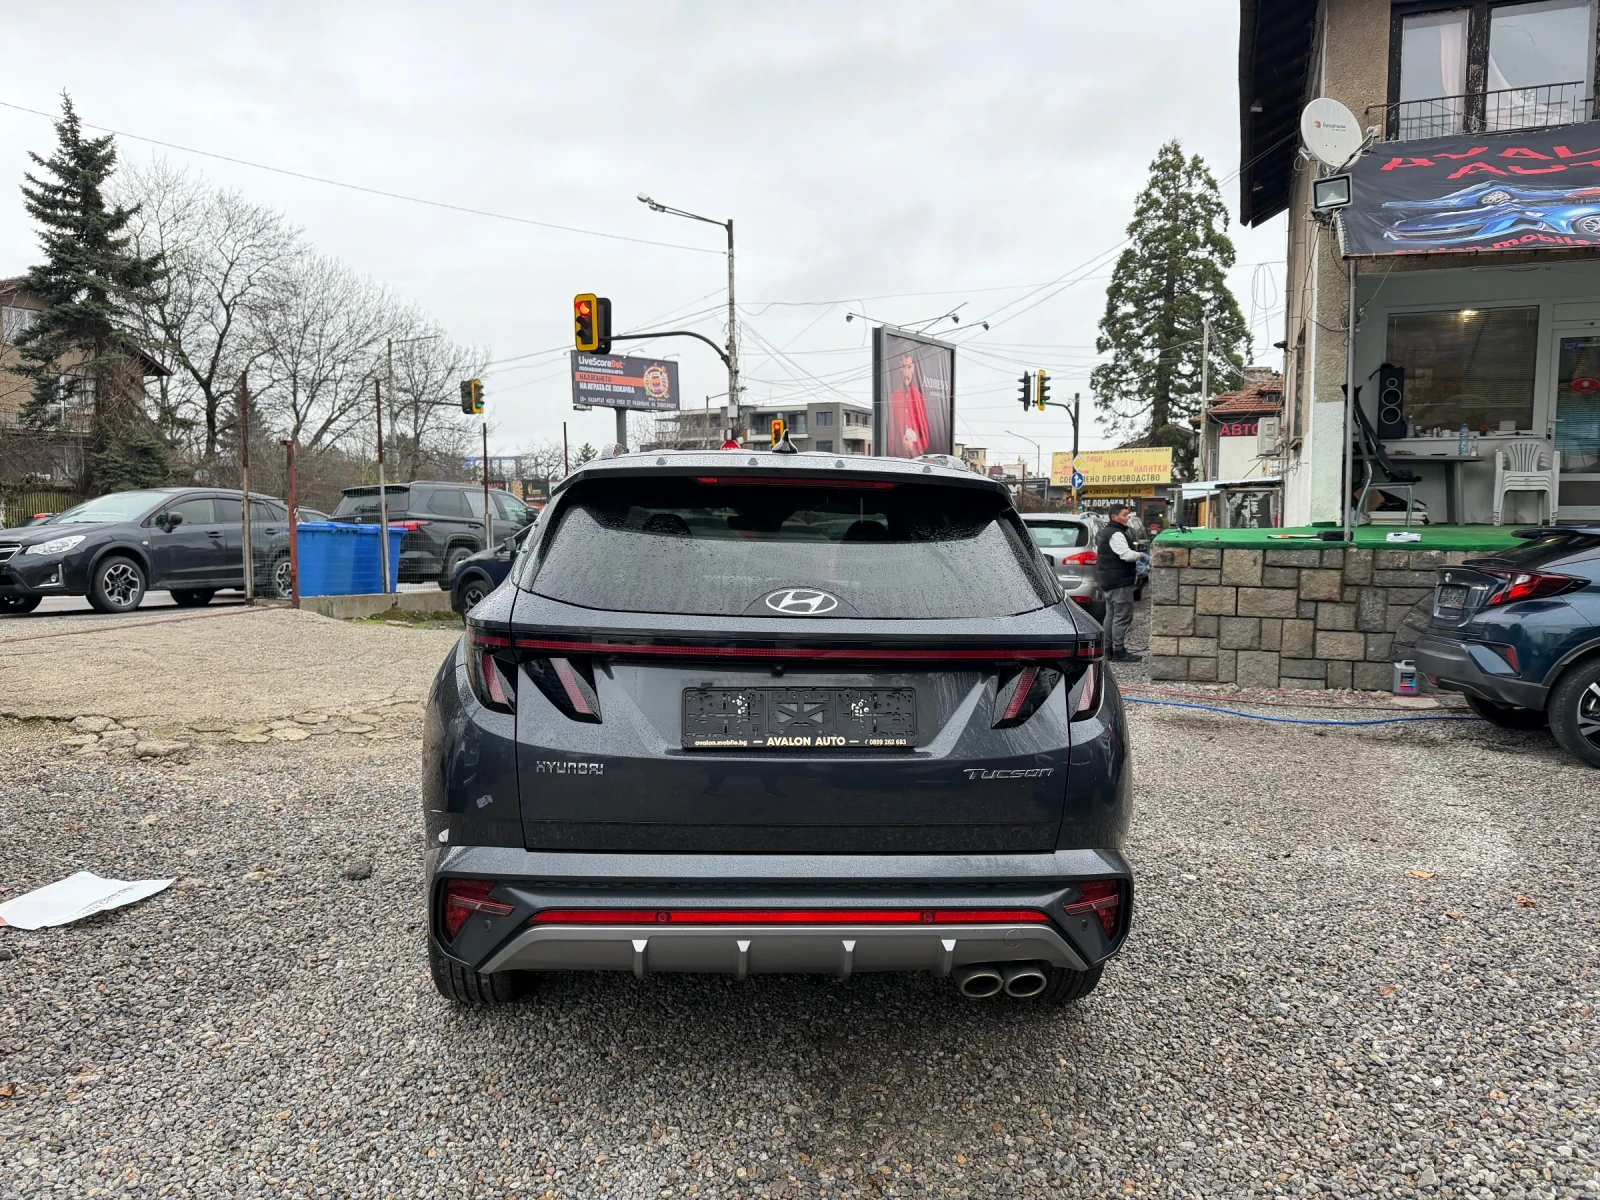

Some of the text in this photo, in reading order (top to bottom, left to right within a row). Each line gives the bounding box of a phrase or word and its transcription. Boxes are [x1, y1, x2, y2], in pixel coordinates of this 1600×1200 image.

[1103, 459, 1134, 468] ЗАКУСКИ
[1134, 464, 1168, 473] НАПИТКИ
[1102, 474, 1160, 483] ПРОИЗВОДСТВО
[767, 737, 811, 746] AVALON
[816, 737, 846, 746] AUTO
[536, 761, 604, 775] HYUNDAI
